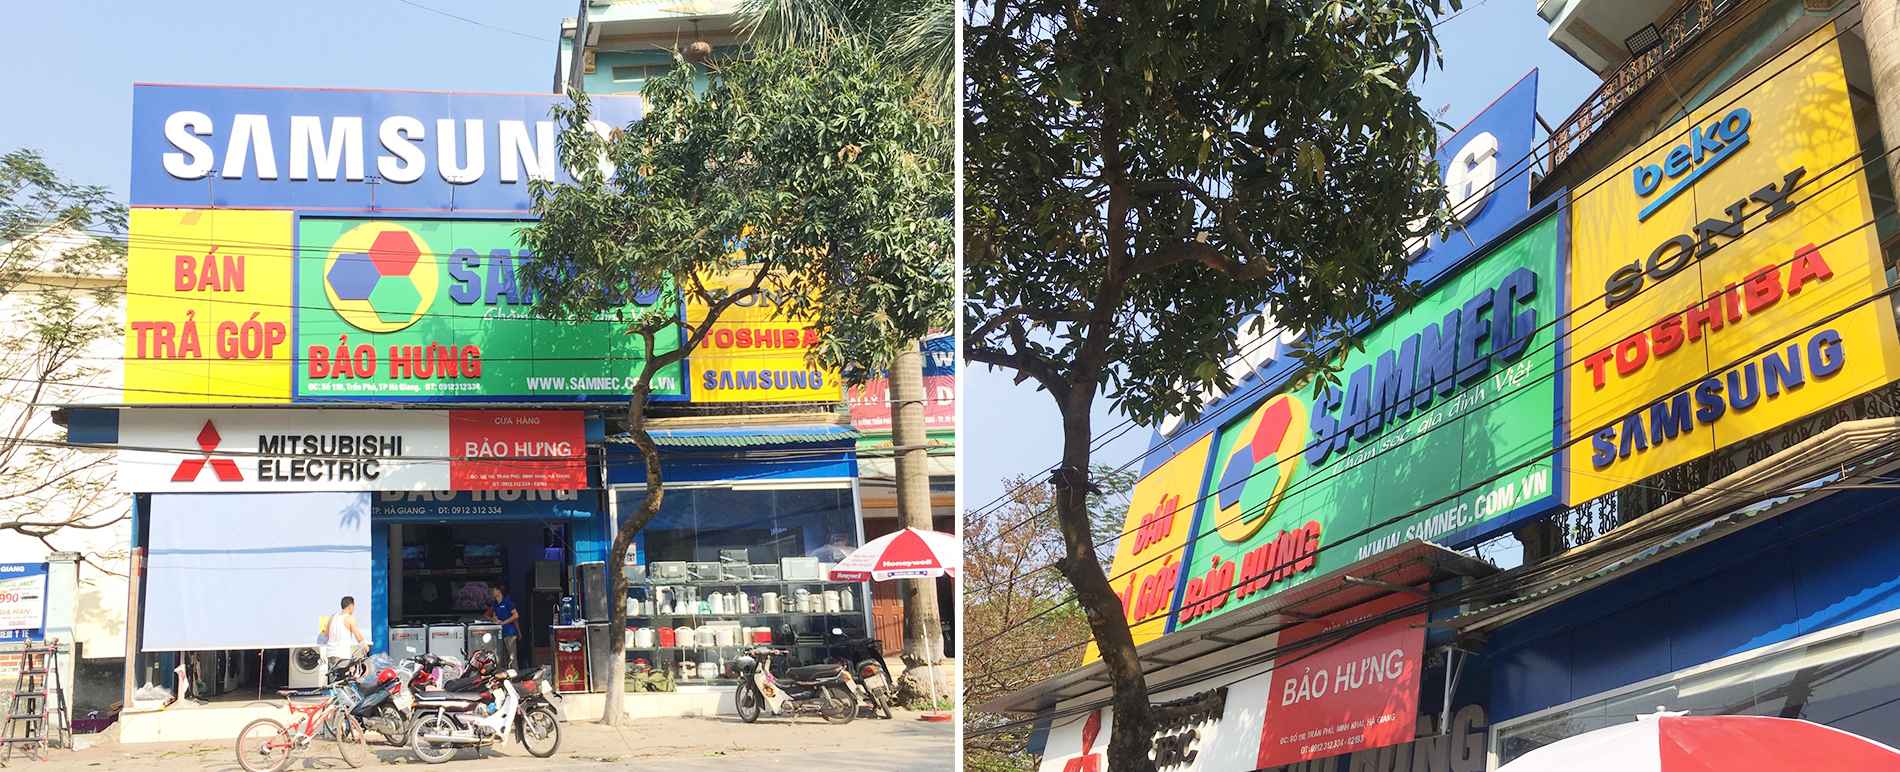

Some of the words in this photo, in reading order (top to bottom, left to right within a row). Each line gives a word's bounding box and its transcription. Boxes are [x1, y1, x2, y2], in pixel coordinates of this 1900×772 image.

[1632, 107, 1753, 198] beko
[1604, 166, 1807, 309] SONY
[174, 246, 246, 292] BÁN
[131, 310, 202, 359] TRẢ
[216, 312, 287, 360] GÓP
[700, 328, 820, 350] TOSHIBA
[1584, 242, 1835, 391] TOSHIBA
[308, 334, 376, 379] BẢO
[389, 340, 482, 379] HƯNG
[703, 369, 824, 390] SAMSUNG
[1305, 266, 1537, 468] SAMNEC
[526, 377, 675, 391] WWW.SAMNEC.C.VN
[1415, 411, 1443, 440] gia
[1494, 359, 1534, 393] Việt
[1591, 329, 1846, 469] SAMSUNG
[494, 415, 513, 425] CỬA
[516, 416, 541, 425] HÀNG
[258, 434, 402, 457] MITSUBISHI
[465, 437, 508, 458] BẢO
[514, 441, 572, 457] HƯNG
[258, 459, 380, 482] ELECTRIC
[384, 504, 397, 515] HÀ
[397, 507, 426, 515] GIANG
[451, 506, 471, 514] 0912
[472, 506, 487, 514] 312
[489, 506, 502, 514] 334
[1131, 493, 1181, 556] BÁN
[1358, 469, 1547, 561] WWWSAMNEC.COM.VN
[836, 572, 862, 580] Honeywell
[882, 559, 932, 567] Honeywell
[1178, 555, 1236, 625] BẢO
[1236, 519, 1322, 600] HƯNG
[1133, 554, 1182, 622] GÓP
[1281, 665, 1329, 708] BẢO
[1334, 648, 1405, 694] HƯNG
[1376, 713, 1396, 724] GIANG
